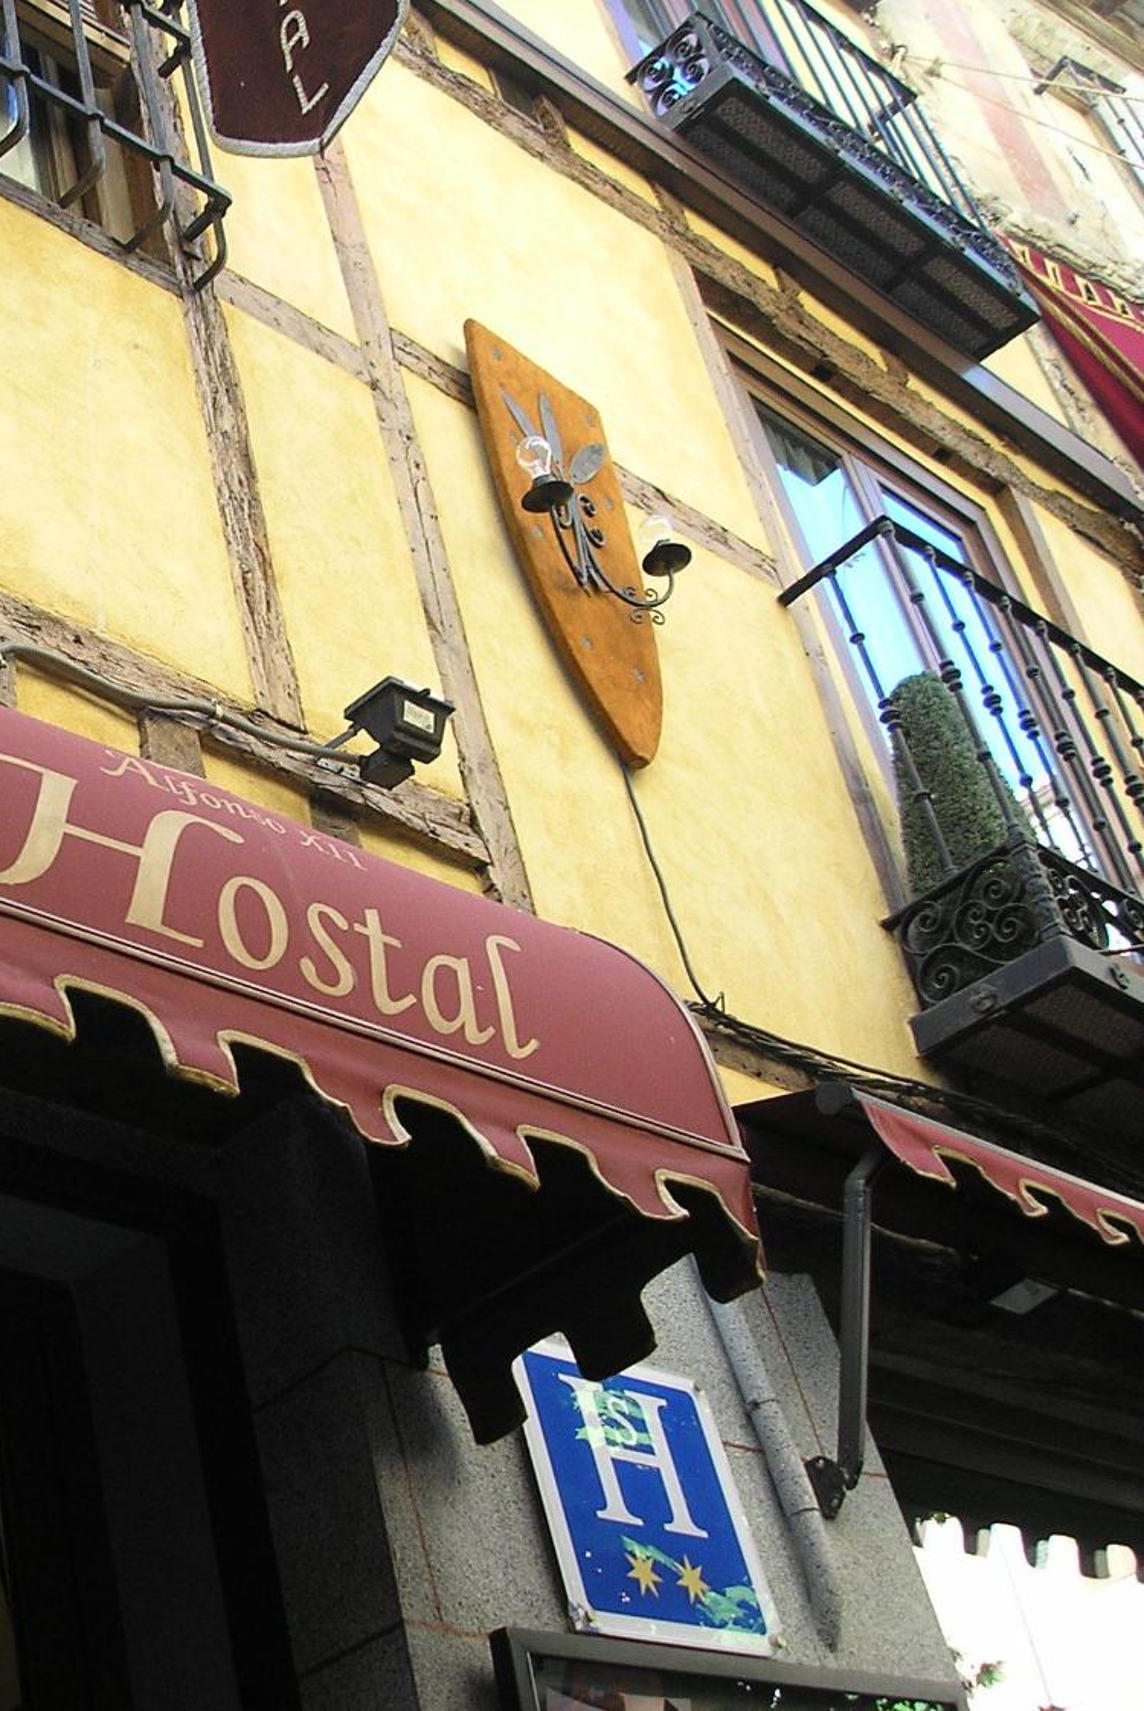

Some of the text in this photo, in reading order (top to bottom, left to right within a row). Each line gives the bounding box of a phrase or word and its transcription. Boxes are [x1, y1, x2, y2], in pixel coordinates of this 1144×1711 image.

[280, 0, 329, 115] AL
[100, 749, 368, 871] Alfonso XII
